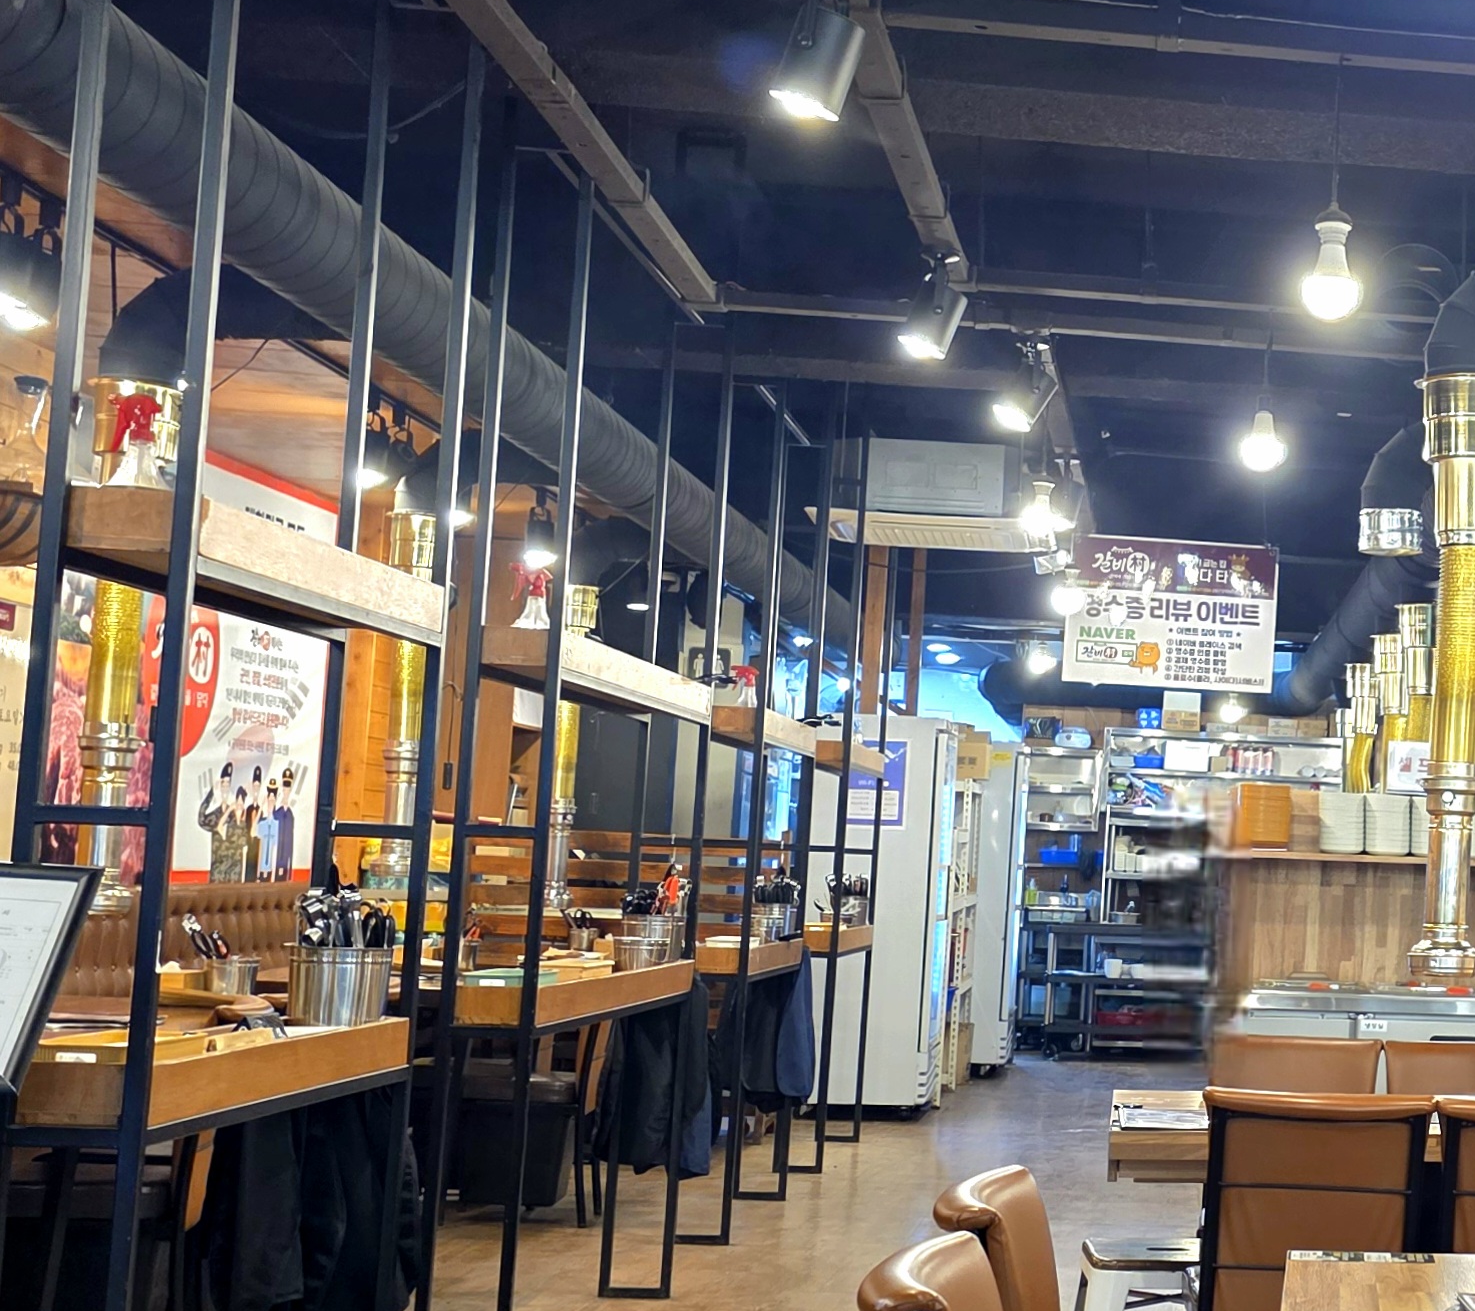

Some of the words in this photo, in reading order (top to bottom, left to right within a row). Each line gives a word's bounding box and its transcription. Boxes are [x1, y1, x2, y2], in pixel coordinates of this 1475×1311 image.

[1150, 598, 1192, 622] 리뷰
[1197, 601, 1260, 626] 이벤트
[1079, 626, 1136, 640] NAVER
